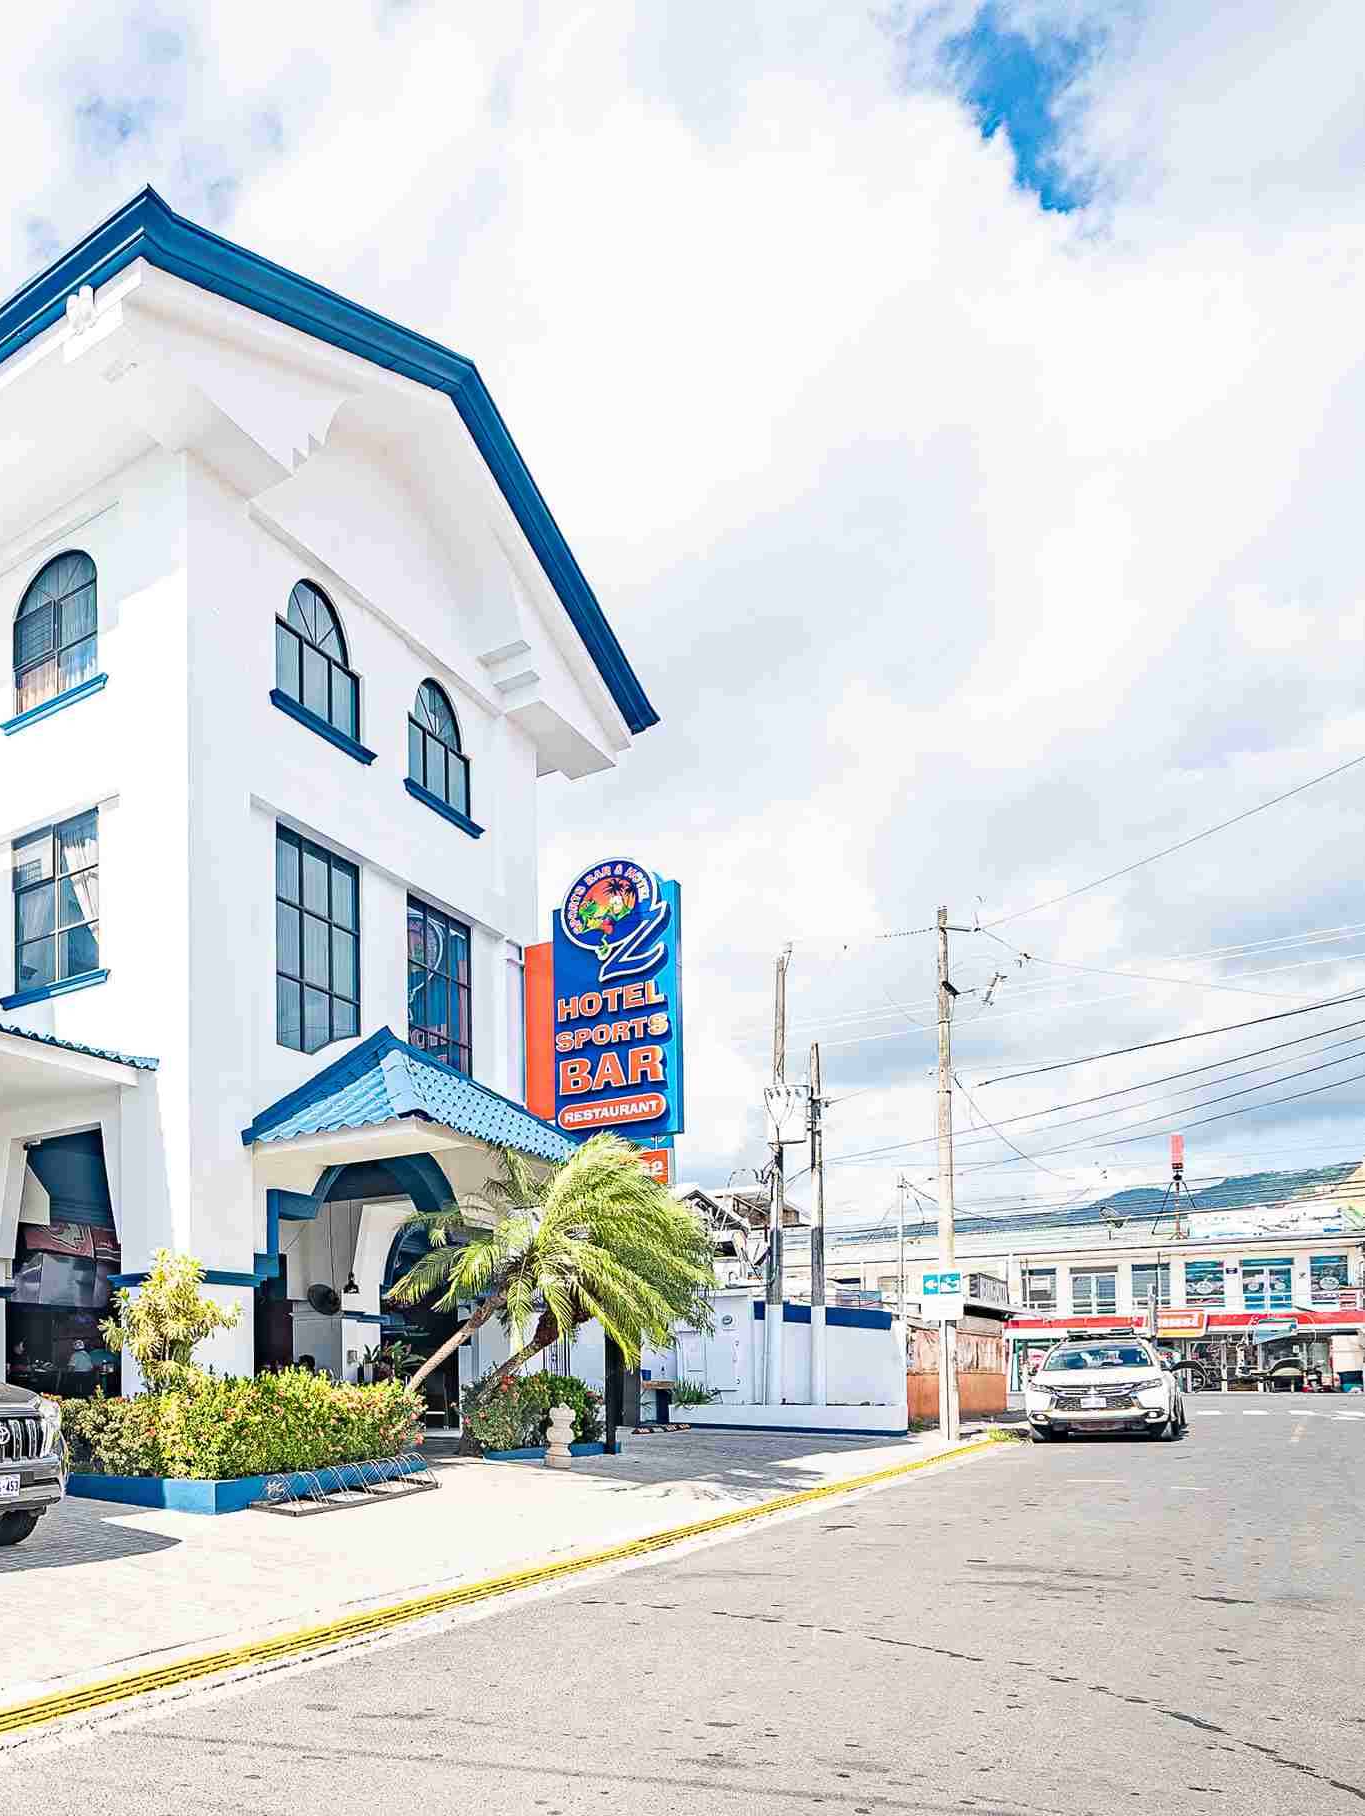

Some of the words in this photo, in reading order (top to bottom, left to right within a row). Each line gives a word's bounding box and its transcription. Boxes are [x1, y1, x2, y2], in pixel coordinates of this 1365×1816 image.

[557, 979, 664, 1022] HOTEL
[555, 1013, 669, 1052] SPORTS
[559, 1045, 665, 1095] BAR
[564, 1100, 659, 1123] RESTAURANT
